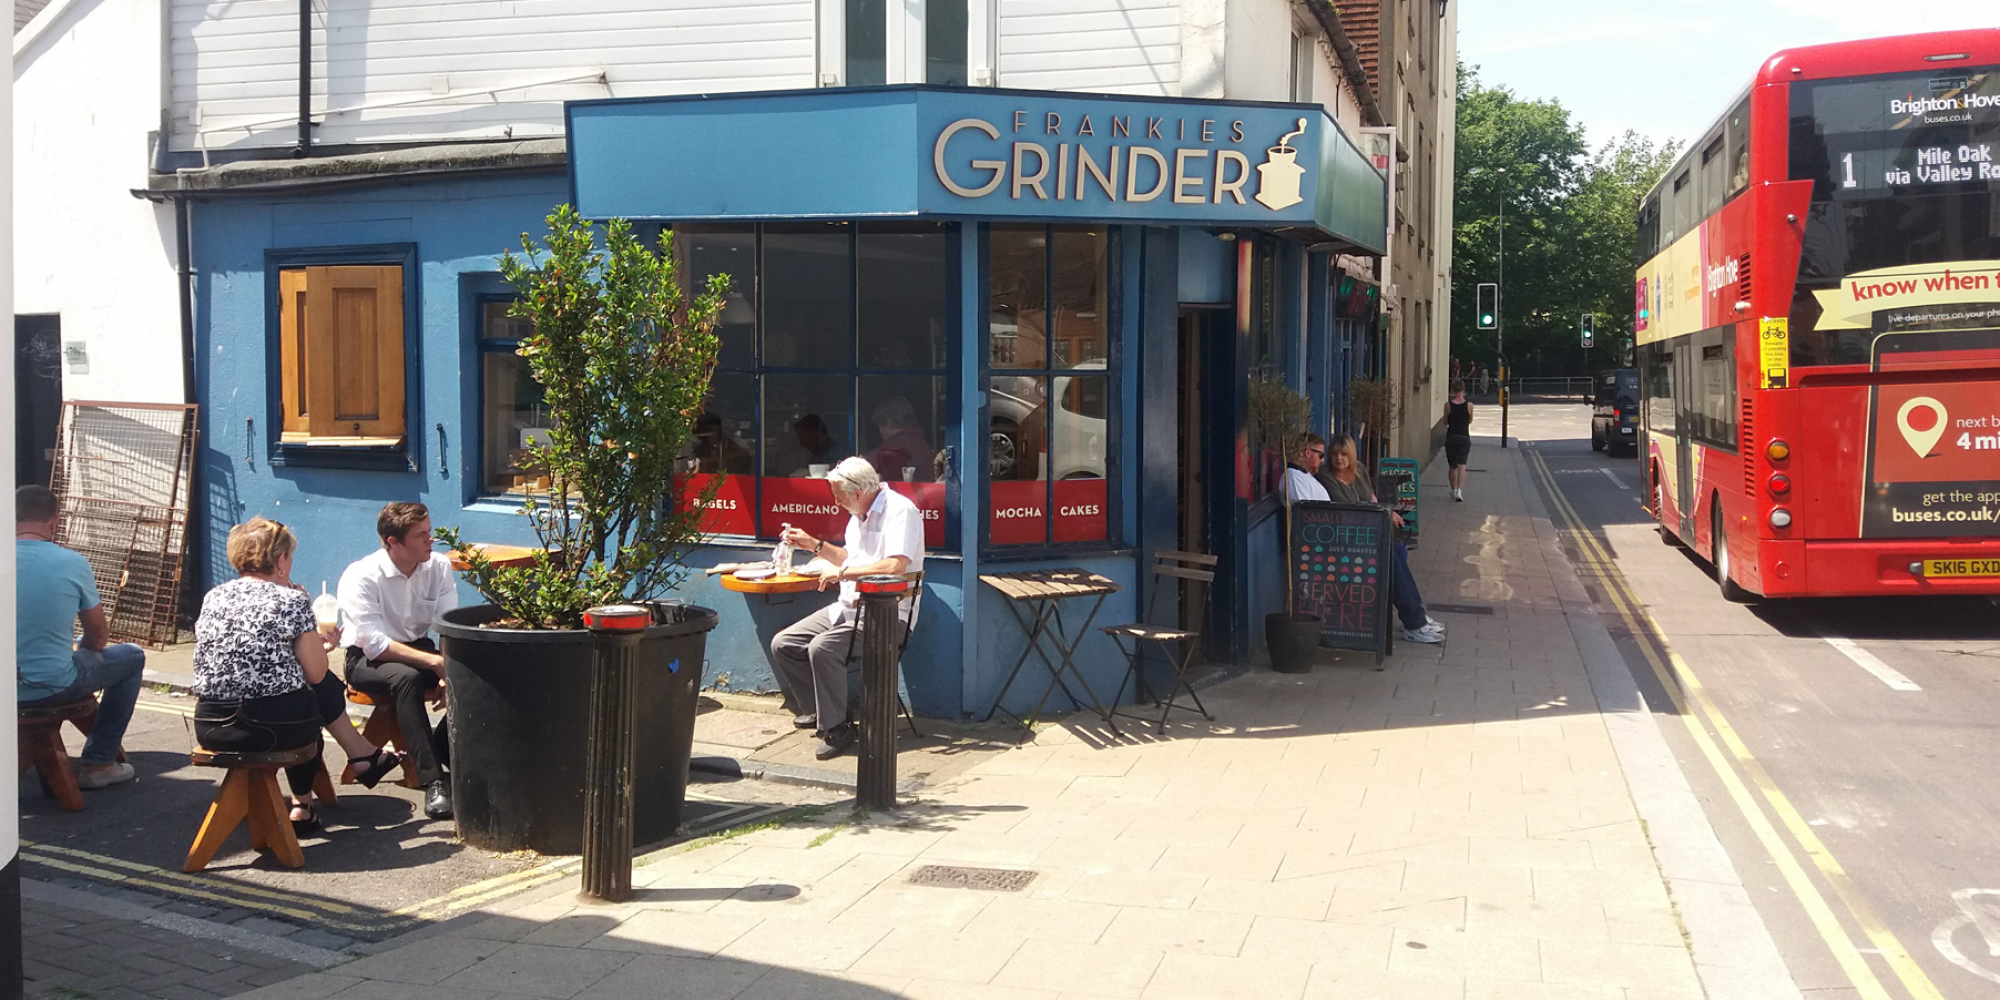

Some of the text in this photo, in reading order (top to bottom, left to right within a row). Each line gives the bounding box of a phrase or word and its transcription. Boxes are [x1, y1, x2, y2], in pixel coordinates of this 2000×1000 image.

[1013, 110, 1245, 144] FRANKIES
[1924, 112, 1973, 124] buses.co.uk
[933, 118, 1250, 205] GRINDER
[1918, 144, 1992, 165] Mile Oak
[1842, 153, 1857, 188] 1
[1886, 167, 1911, 185] via
[1917, 164, 1973, 183] Valley
[1851, 279, 1918, 302] know
[1923, 269, 1989, 292] when
[1888, 314, 1903, 324] live
[1905, 312, 1950, 324] departures
[1951, 311, 1964, 319] on
[1965, 311, 1984, 320] your
[1956, 416, 1987, 428] next
[1956, 432, 1971, 450] 4
[1922, 492, 1946, 507] get
[1949, 489, 1973, 503] the
[771, 503, 839, 515] AMERICANO
[995, 507, 1042, 519] MOCHA
[1060, 504, 1100, 517] CAKES
[1304, 512, 1341, 524] SMALL
[1302, 523, 1378, 546] COFFEE
[1933, 560, 2000, 574] SK16 GXD
[1298, 581, 1376, 604] SERVED
[1298, 599, 1374, 631] HERE
